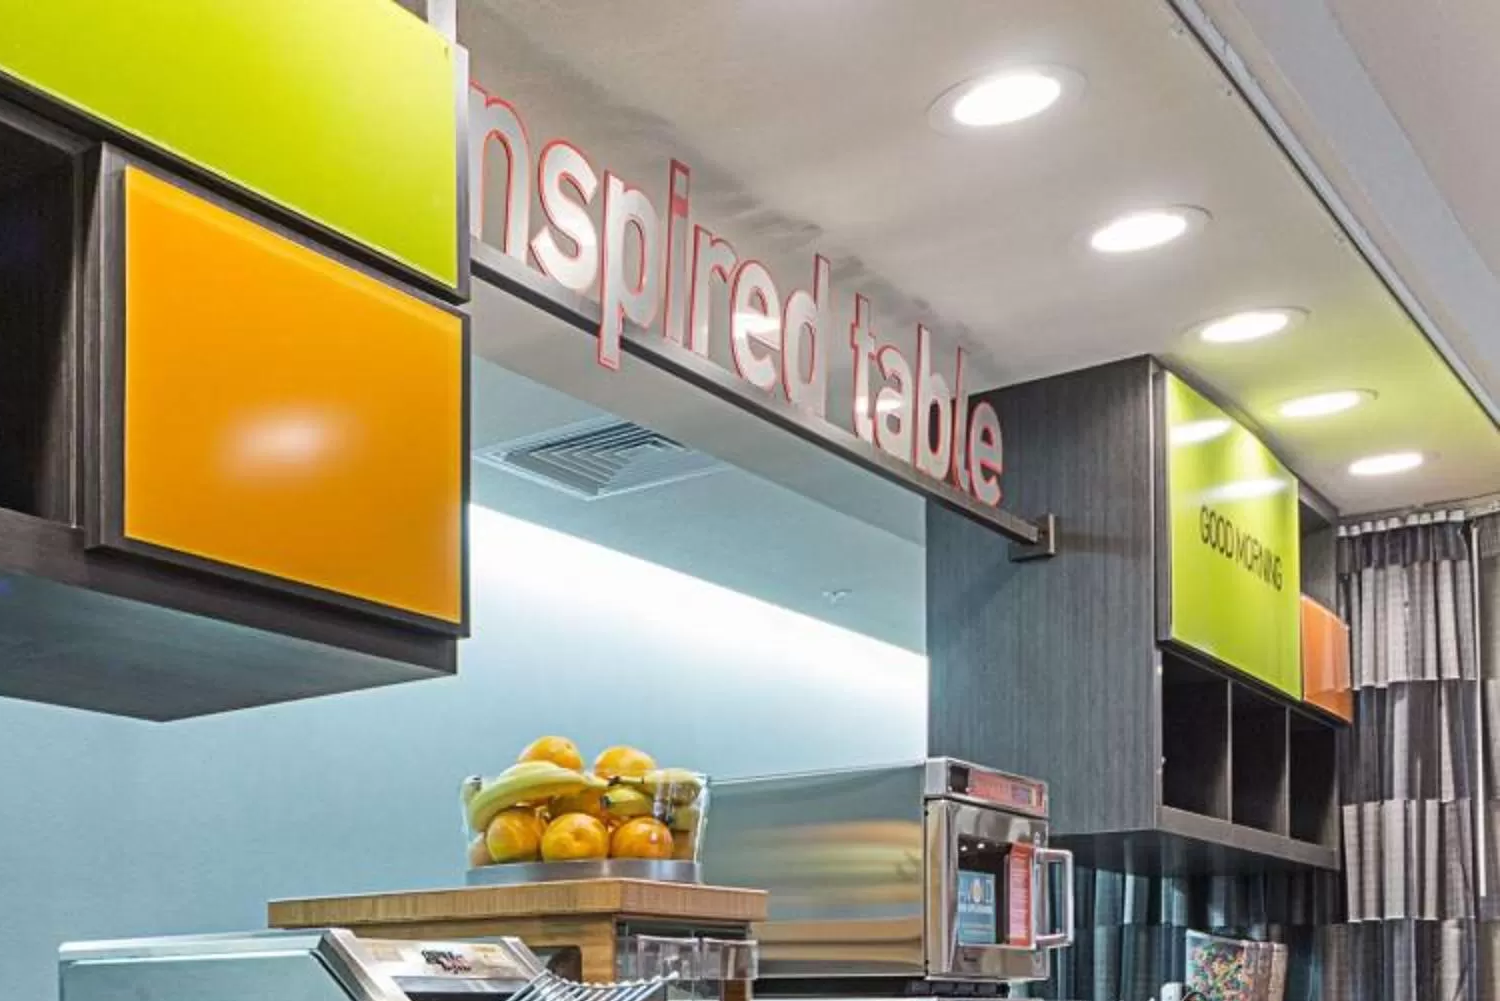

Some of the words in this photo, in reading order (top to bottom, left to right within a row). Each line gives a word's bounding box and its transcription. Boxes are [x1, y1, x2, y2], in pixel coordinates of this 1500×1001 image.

[851, 292, 1002, 507] table
[1200, 504, 1234, 559] GOOD
[1235, 525, 1283, 592] MORNING
